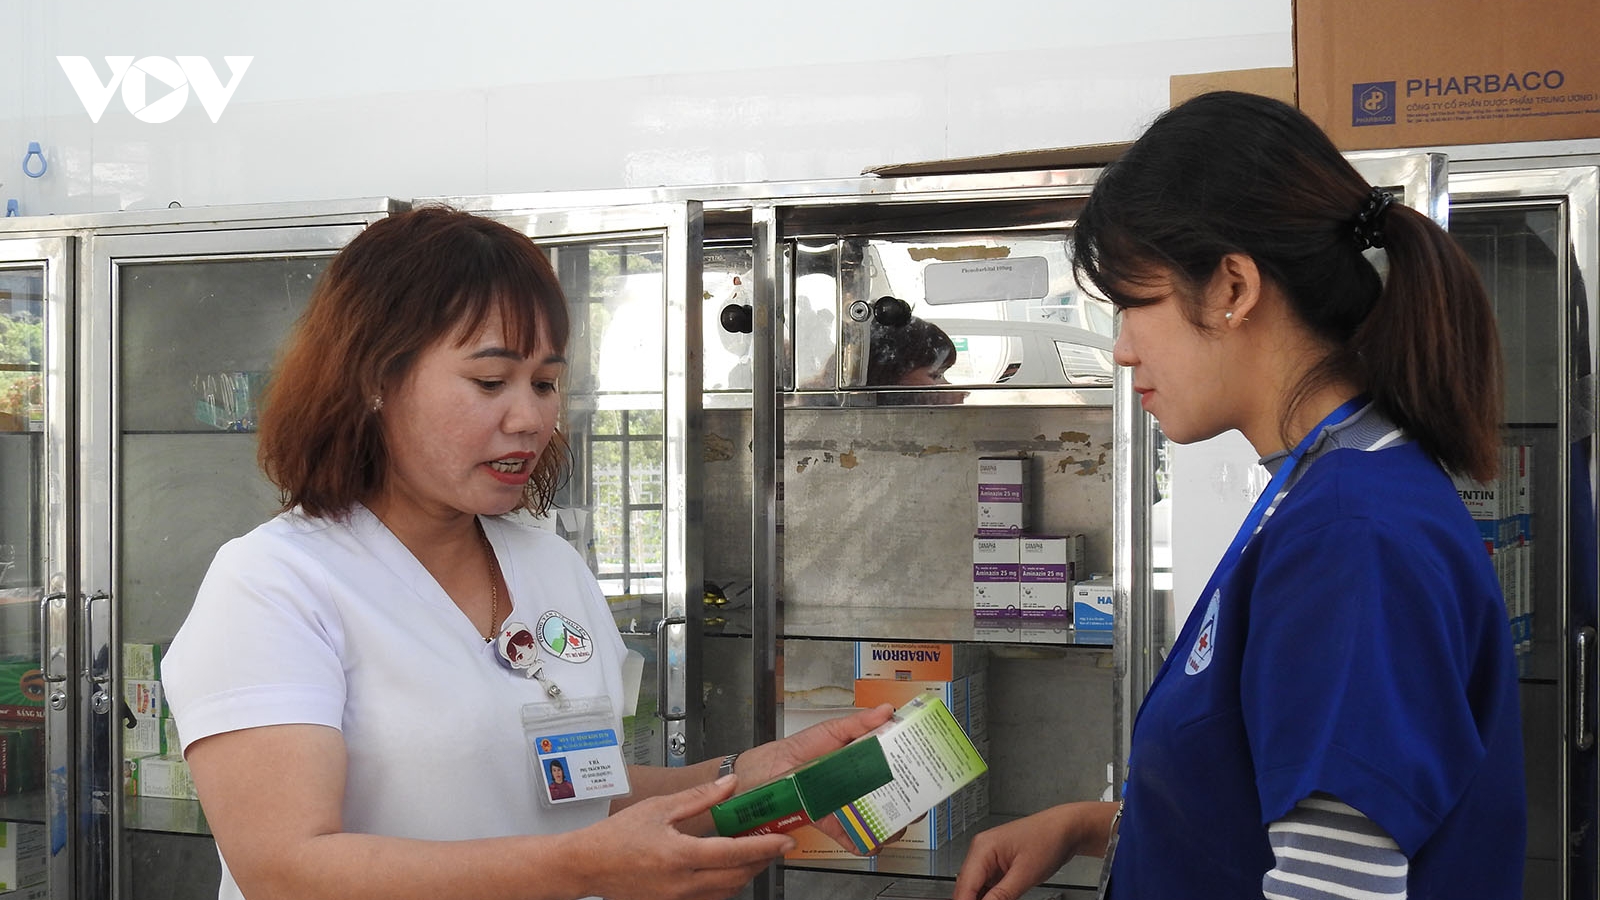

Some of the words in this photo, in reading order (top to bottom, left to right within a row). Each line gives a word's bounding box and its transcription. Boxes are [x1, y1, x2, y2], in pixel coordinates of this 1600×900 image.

[1406, 69, 1565, 98] PHARBACO
[1022, 570, 1047, 578] Aminazin
[1047, 570, 1055, 578] 25
[872, 649, 941, 662] ANBABROM
